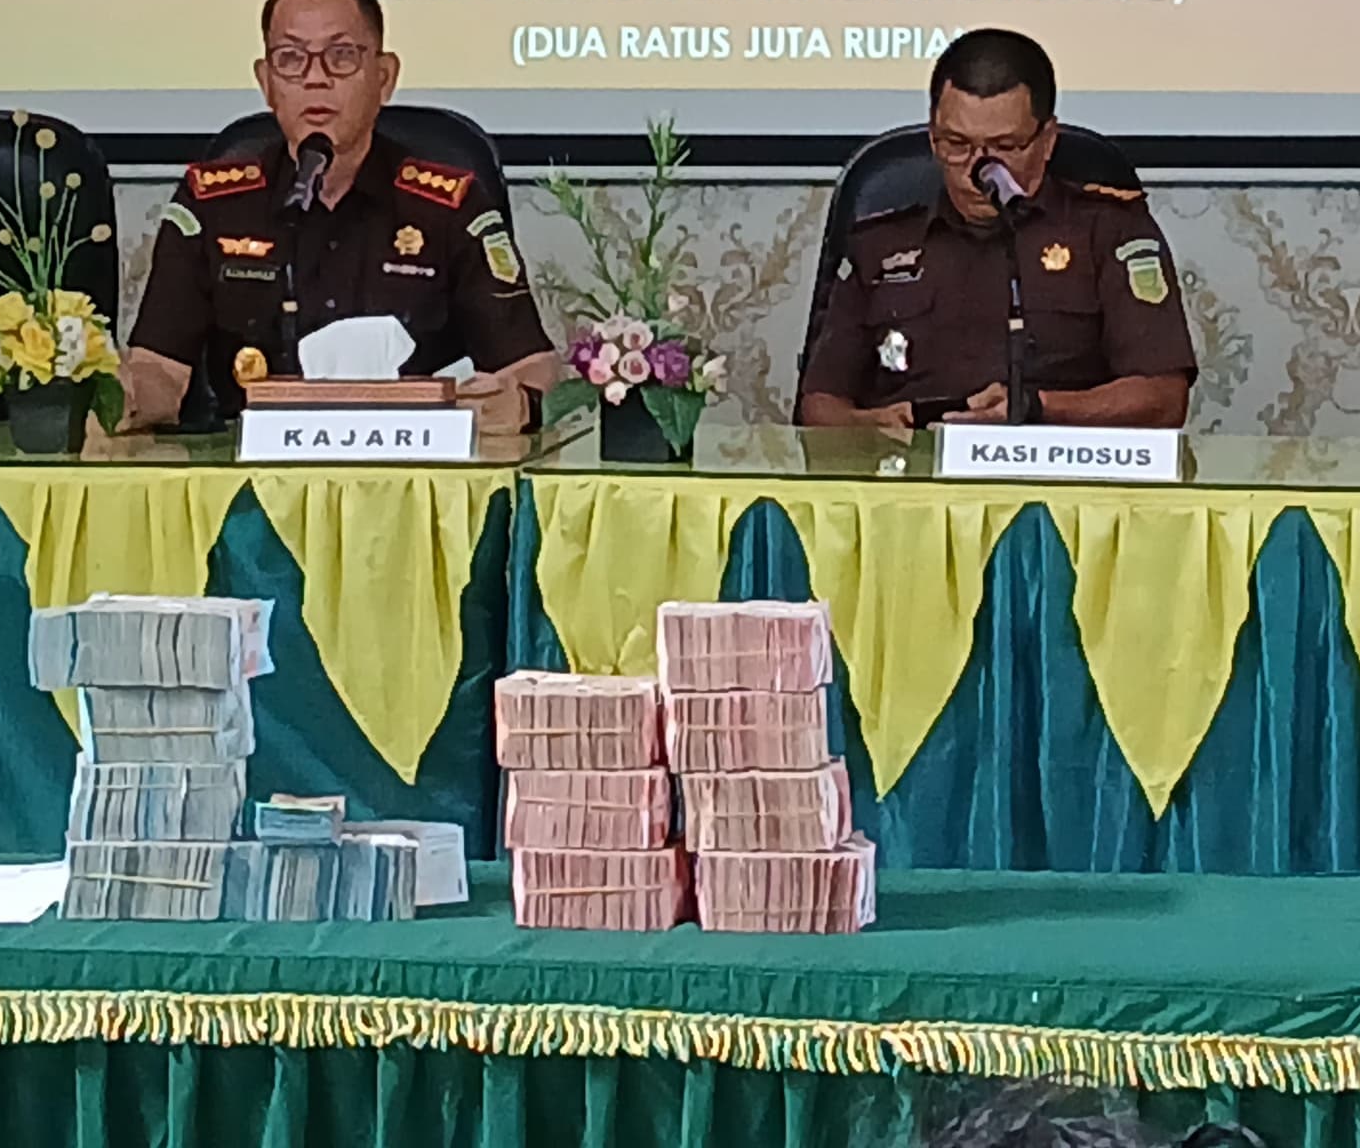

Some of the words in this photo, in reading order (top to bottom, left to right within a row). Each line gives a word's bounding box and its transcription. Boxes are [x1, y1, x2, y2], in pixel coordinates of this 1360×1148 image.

[513, 26, 607, 66] (DUA
[620, 26, 730, 58] RATUS
[743, 26, 831, 58] JUTA
[843, 26, 967, 60] RUPIA
[283, 428, 431, 447] KAJARI
[970, 443, 1038, 463] KASI
[1047, 445, 1152, 466] PIDSUS
